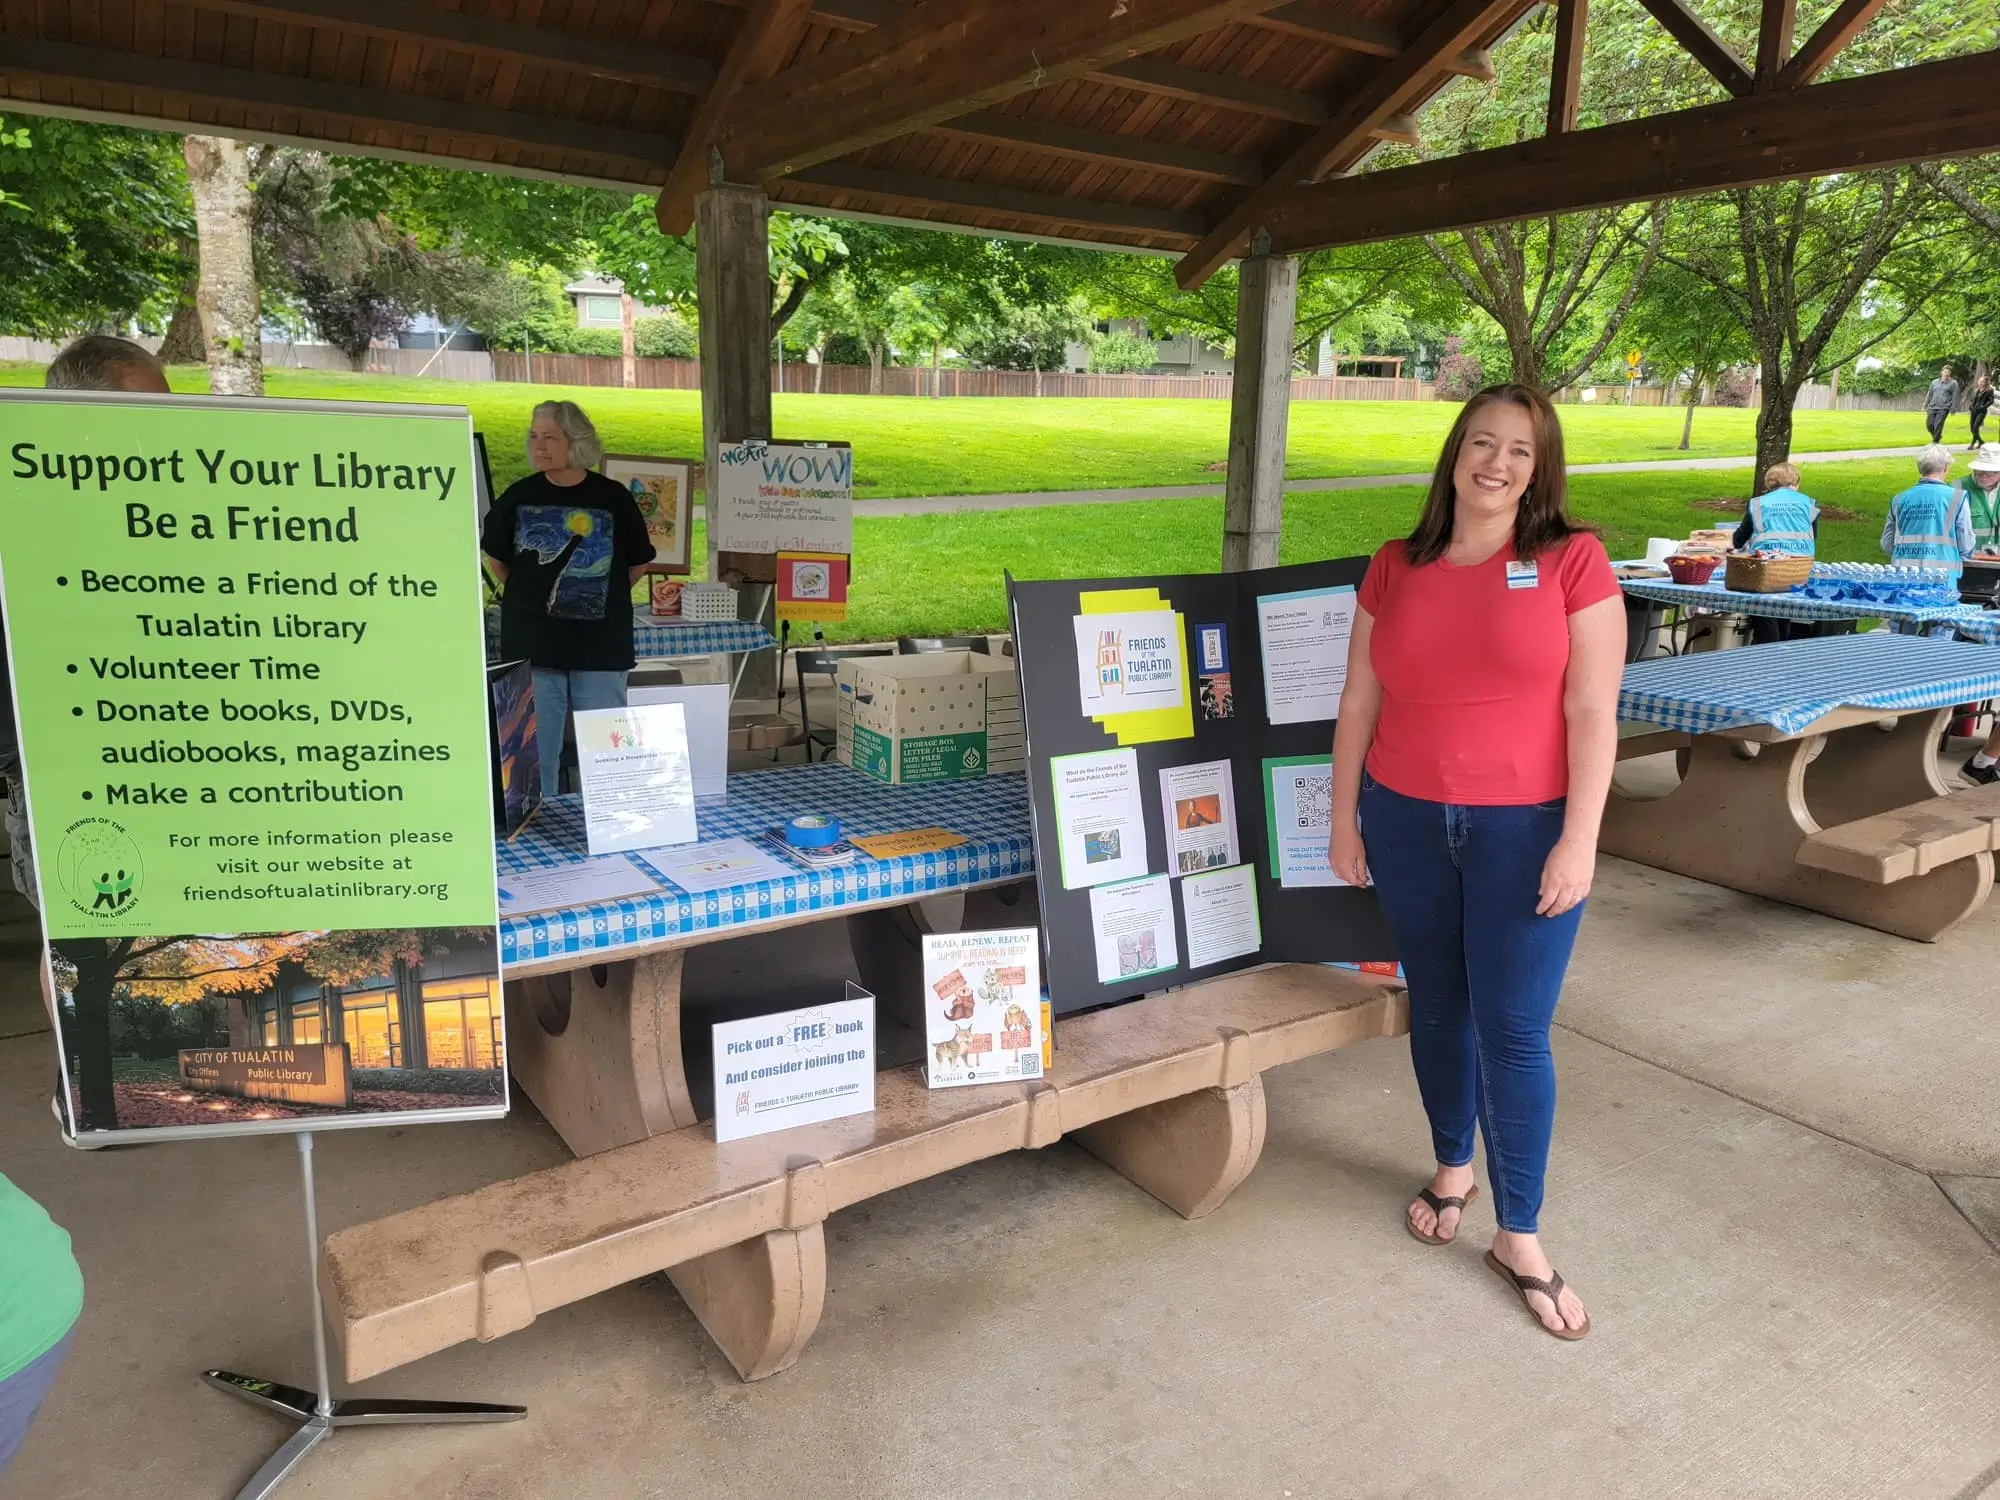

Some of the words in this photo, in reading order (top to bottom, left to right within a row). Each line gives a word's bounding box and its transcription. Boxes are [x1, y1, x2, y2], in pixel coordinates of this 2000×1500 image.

[12, 443, 185, 490] Support
[196, 448, 300, 486] Your
[314, 452, 456, 500] Library
[126, 503, 178, 538] Be
[191, 513, 214, 540] a
[227, 505, 359, 542] Friend
[1763, 542, 1809, 550] RIVERPARK
[81, 570, 205, 593] Become
[218, 576, 235, 594] a
[248, 572, 338, 596] Friend
[349, 572, 378, 596] of
[388, 574, 438, 597] the
[137, 614, 260, 637] Tualatin
[273, 616, 367, 644] Library
[1128, 638, 1166, 651] FRIENDS
[89, 657, 240, 680] Volunteer
[250, 658, 320, 680] Time
[1128, 658, 1172, 674] TUALATIN
[1128, 674, 1148, 682] PUBLIC
[1149, 672, 1172, 681] LIBRARY
[98, 700, 209, 722] Donate
[221, 698, 319, 725] books,
[330, 700, 413, 725] DVDs,
[903, 740, 938, 748] STORAGE
[102, 741, 286, 766] audiobooks,
[297, 741, 450, 771] magazines
[922, 754, 941, 762] FILES
[106, 782, 188, 805] Make
[200, 787, 217, 804] a
[229, 780, 403, 804] contribution
[66, 818, 96, 834] FRIENDS
[112, 821, 126, 834] THE
[169, 833, 200, 848] For
[208, 834, 259, 847] more
[267, 829, 382, 846] information
[390, 828, 454, 848] please
[216, 857, 259, 874] visit
[270, 859, 300, 872] our
[308, 856, 384, 872] website
[393, 856, 412, 870] at
[184, 880, 448, 903] friendsoftualatinlibrary.org
[70, 899, 108, 918] TUALATIN
[110, 897, 139, 918] LIBRARY
[998, 934, 1031, 944] REPEAT
[970, 947, 998, 960] READING
[728, 1040, 752, 1055] Pick
[755, 1037, 774, 1050] out
[776, 1036, 784, 1044] a
[793, 1022, 826, 1042] FREE
[836, 1020, 864, 1034] book
[195, 1052, 212, 1064] CITY
[216, 1052, 228, 1064] OF
[232, 1050, 294, 1064] TUALATIN
[726, 1070, 748, 1084] And
[751, 1060, 802, 1080] consider
[804, 1052, 844, 1070] joining
[847, 1050, 866, 1062] the
[247, 1068, 275, 1078] Public
[276, 1069, 312, 1082] Library
[754, 1098, 780, 1109] FRIENDS
[786, 1091, 814, 1102] TUALATIN
[814, 1088, 834, 1096] PUBLIC
[835, 1083, 860, 1094] LIBRARY
